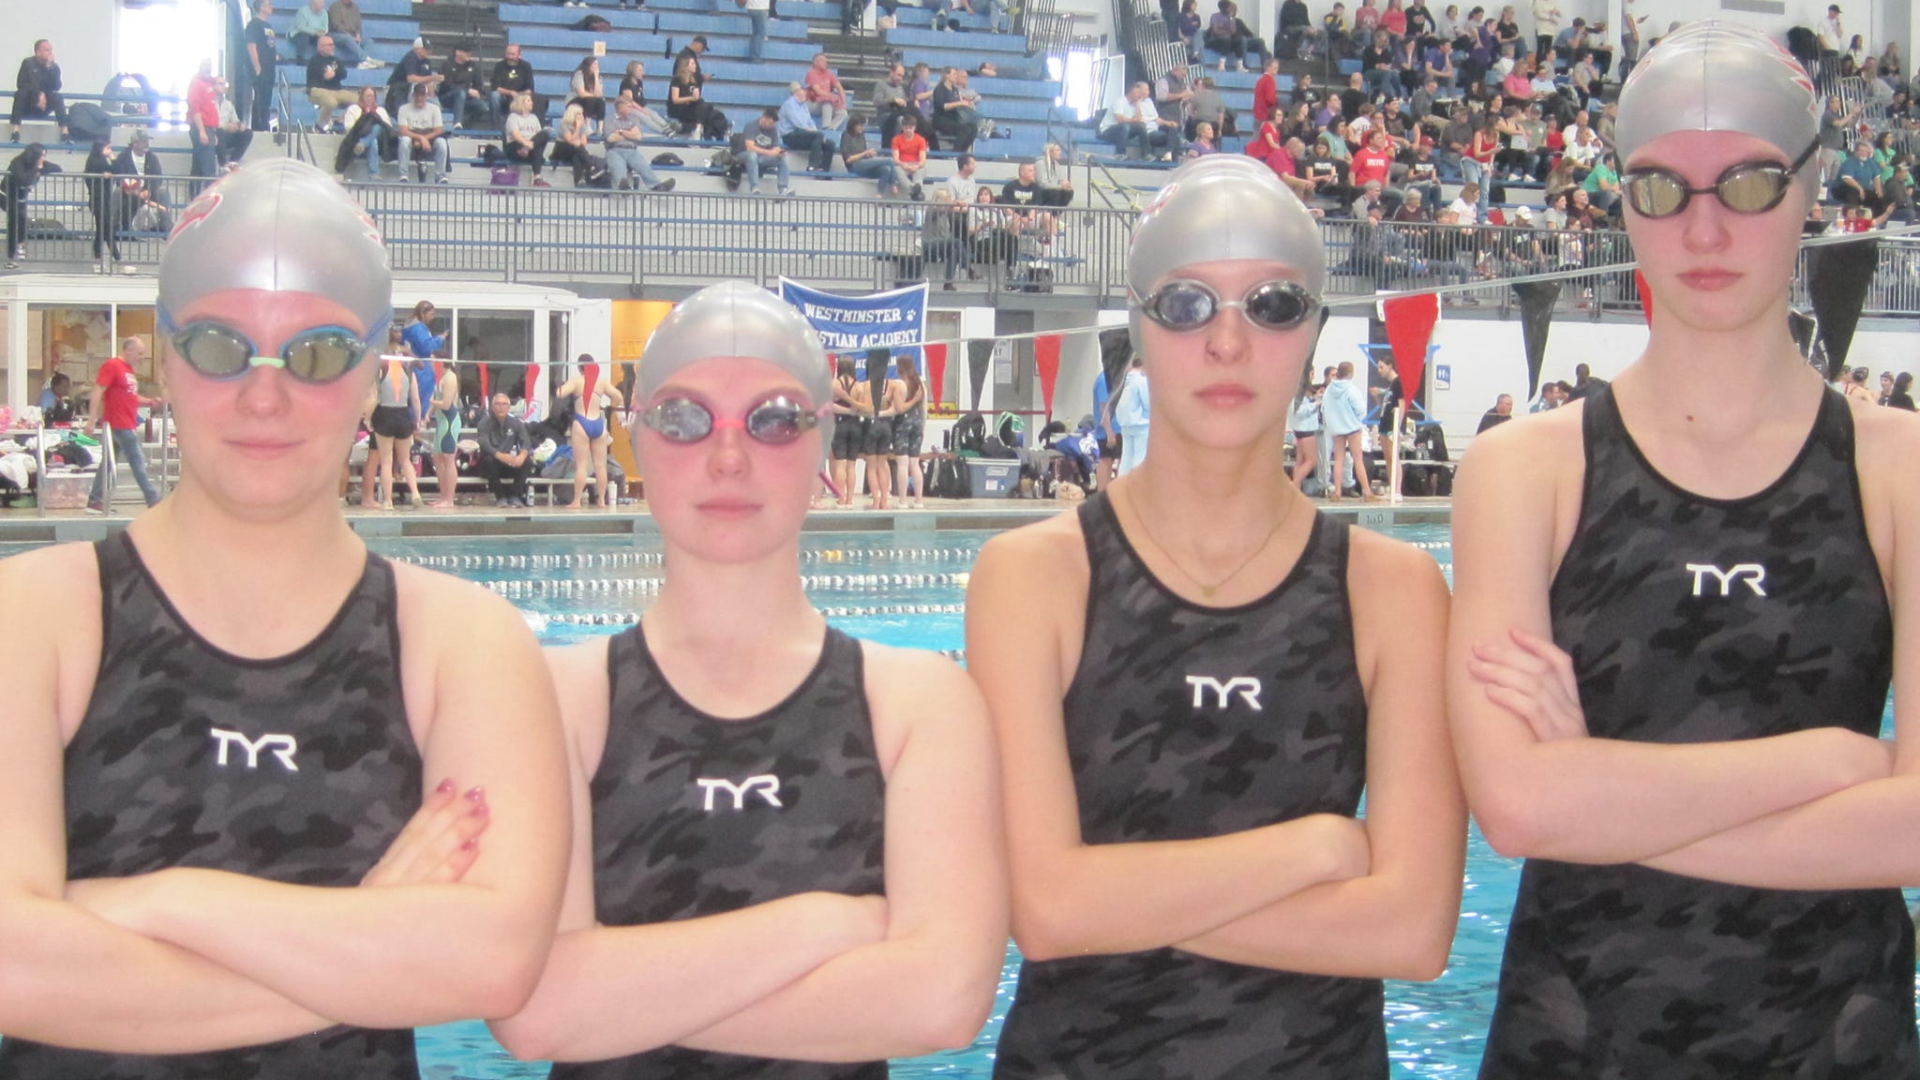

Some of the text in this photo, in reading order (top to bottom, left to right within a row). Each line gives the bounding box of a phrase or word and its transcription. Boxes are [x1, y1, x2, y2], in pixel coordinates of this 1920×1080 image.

[804, 302, 902, 324] WESTMINSTER
[818, 328, 918, 348] STIAN ACADEMY
[1686, 563, 1767, 597] TYR
[1186, 675, 1262, 711] TYR
[211, 728, 298, 772] TYR
[697, 774, 782, 812] TYR
